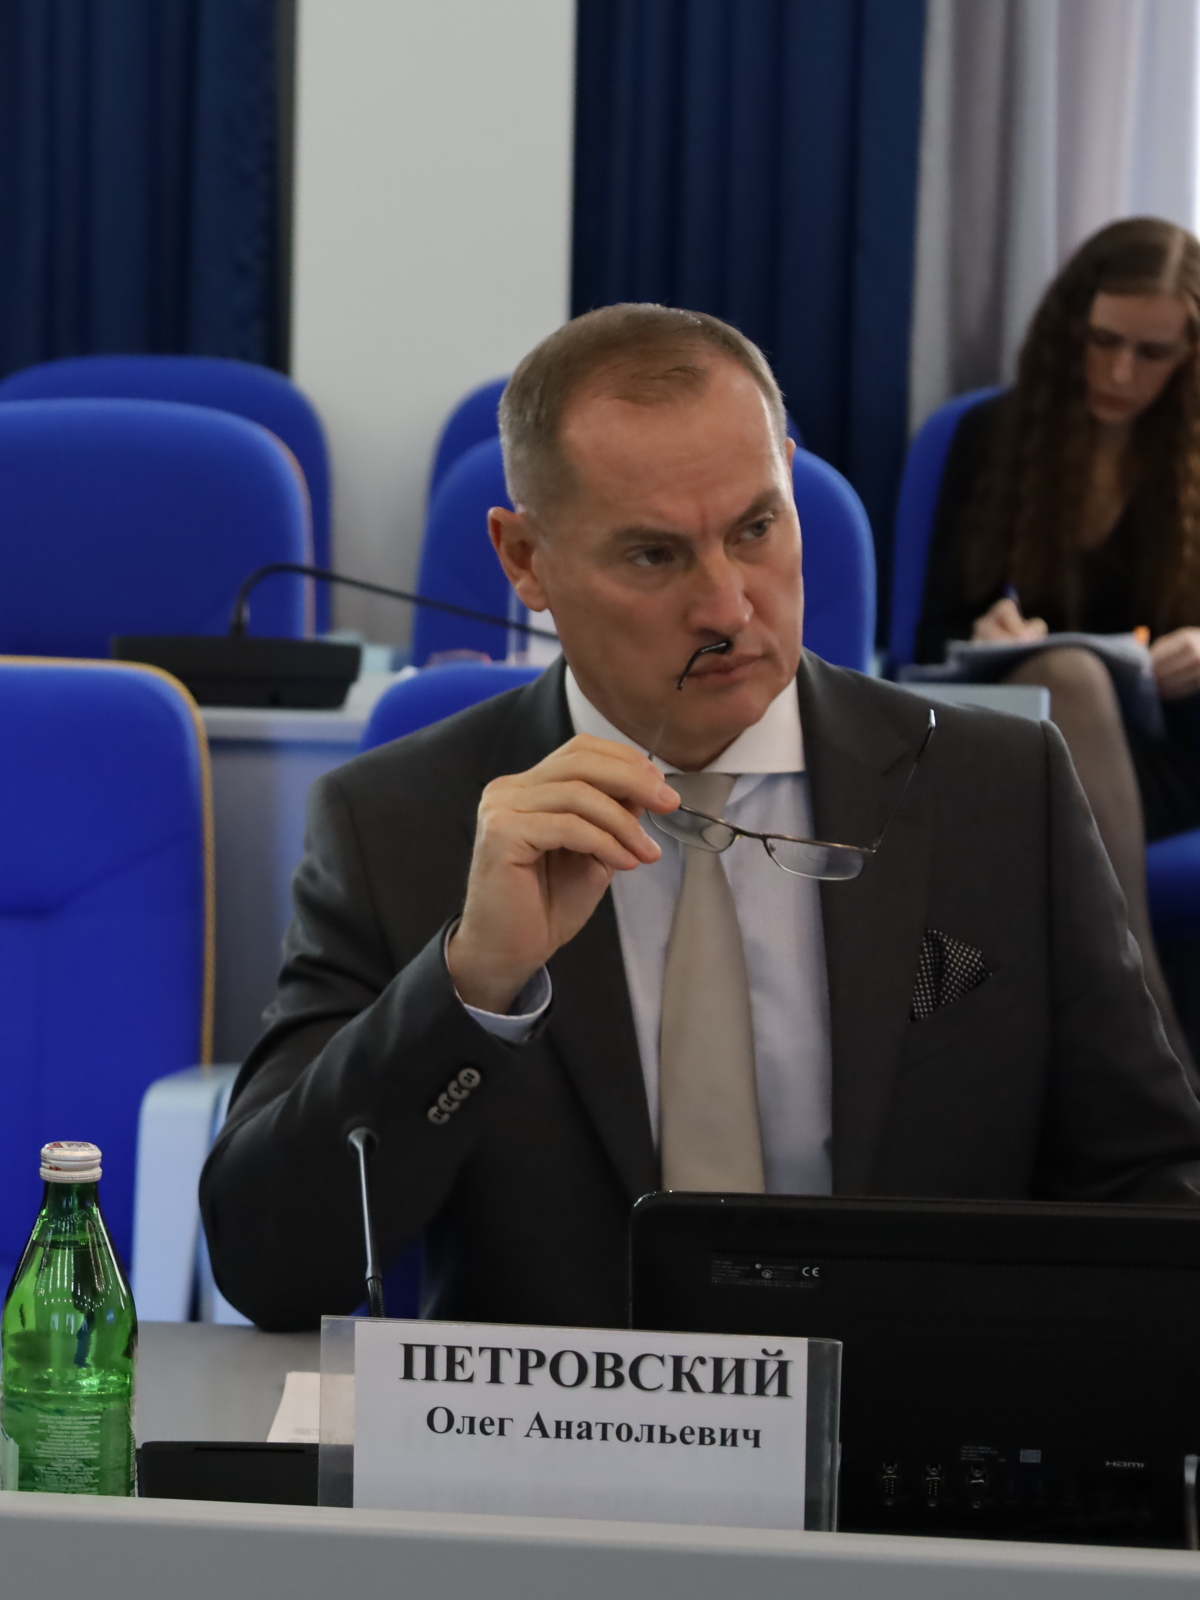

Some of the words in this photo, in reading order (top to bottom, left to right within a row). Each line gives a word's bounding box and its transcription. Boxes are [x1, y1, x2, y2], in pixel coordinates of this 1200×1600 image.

[399, 1342, 794, 1398] ПЕТРОВСКИЙ
[426, 1405, 514, 1438] Олег
[524, 1411, 762, 1449] Анатольевич
[1105, 1460, 1145, 1469] HDMI
